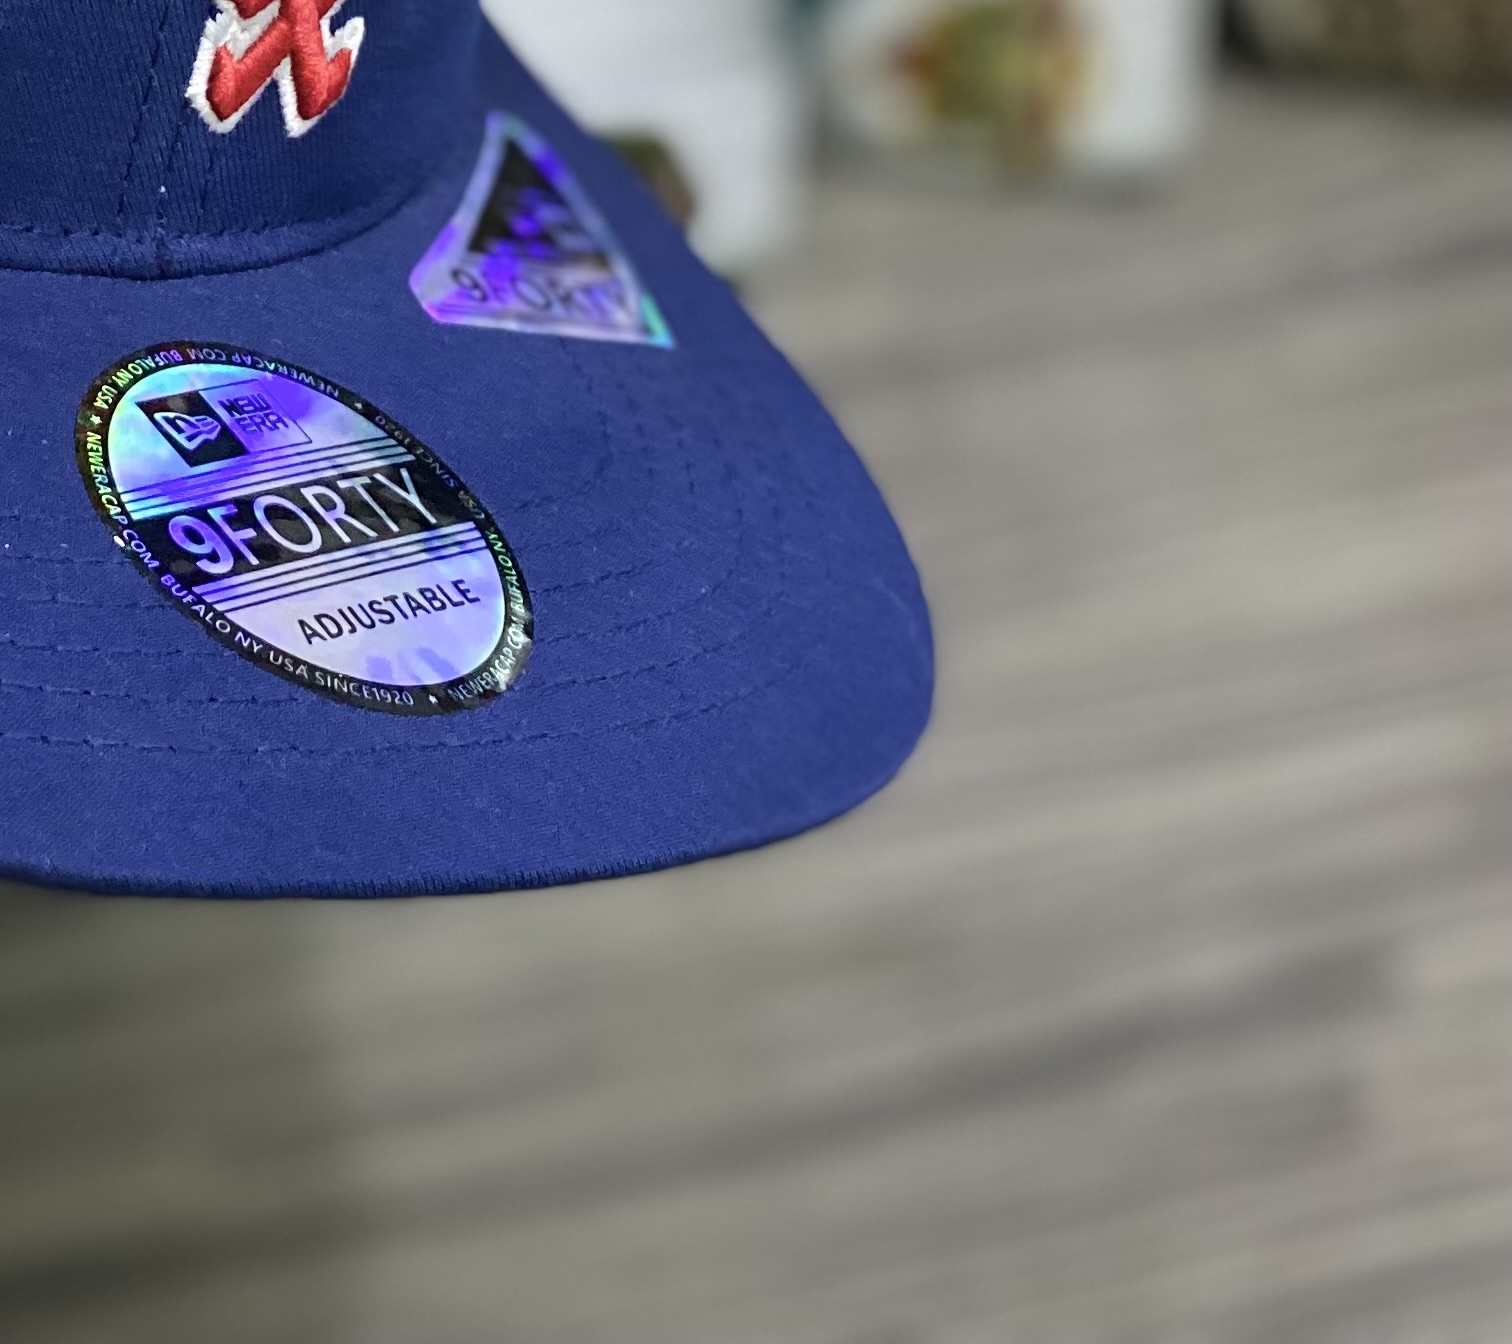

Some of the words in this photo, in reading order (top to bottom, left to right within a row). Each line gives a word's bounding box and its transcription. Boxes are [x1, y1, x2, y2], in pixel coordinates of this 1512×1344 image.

[218, 392, 272, 418] NEW
[236, 412, 289, 434] ERA
[168, 467, 436, 576] 9FORTY
[299, 578, 481, 645] ADJUSTABLE
[269, 650, 309, 680] USA
